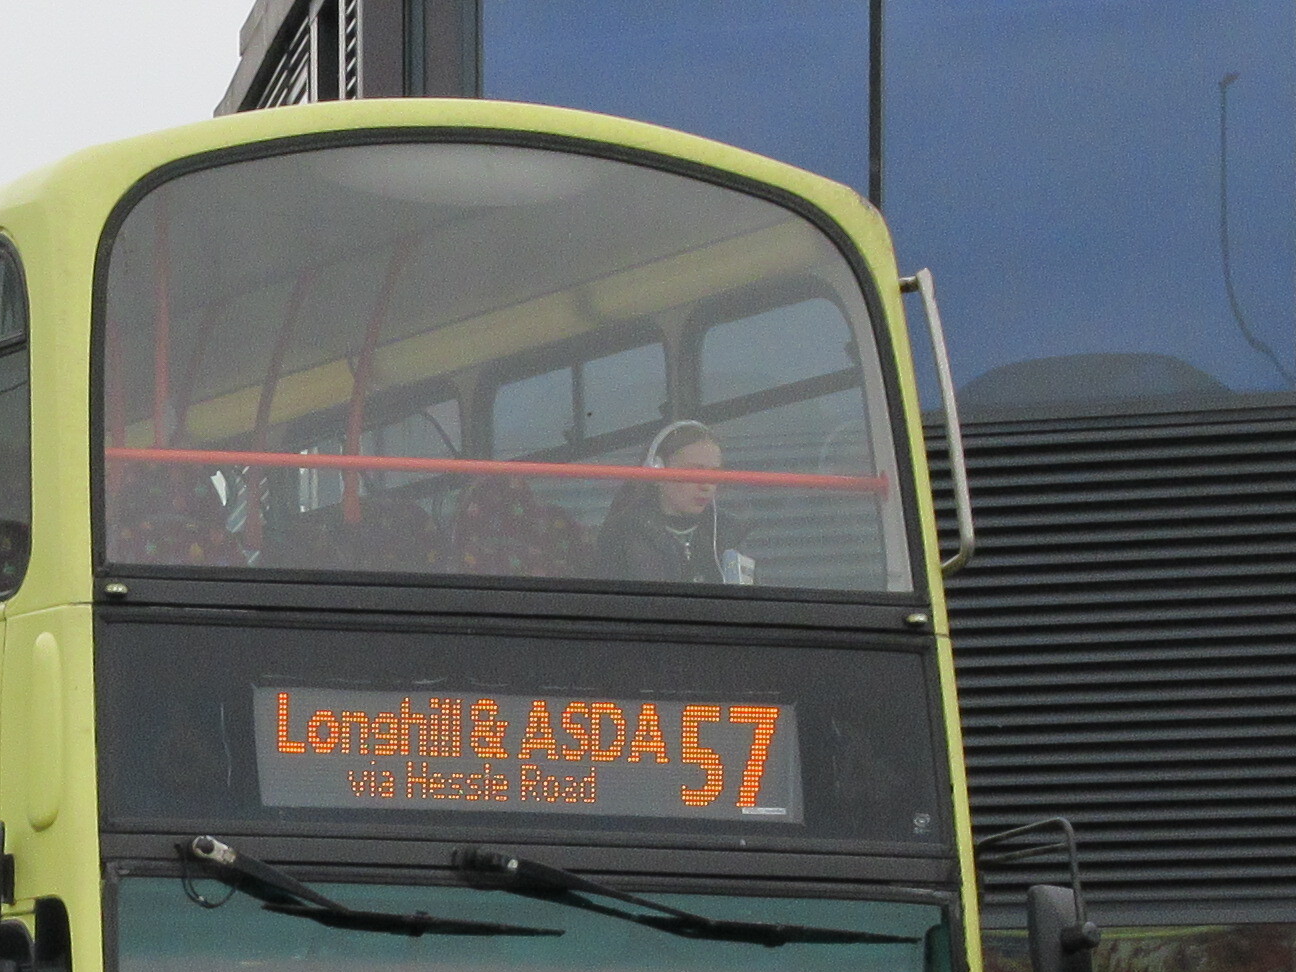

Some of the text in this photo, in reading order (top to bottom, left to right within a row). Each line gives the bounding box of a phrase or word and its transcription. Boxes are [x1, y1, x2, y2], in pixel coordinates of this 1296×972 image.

[277, 692, 670, 764] Longhill & ASDA
[680, 704, 779, 807] 57
[347, 761, 596, 803] via Hessle Road
